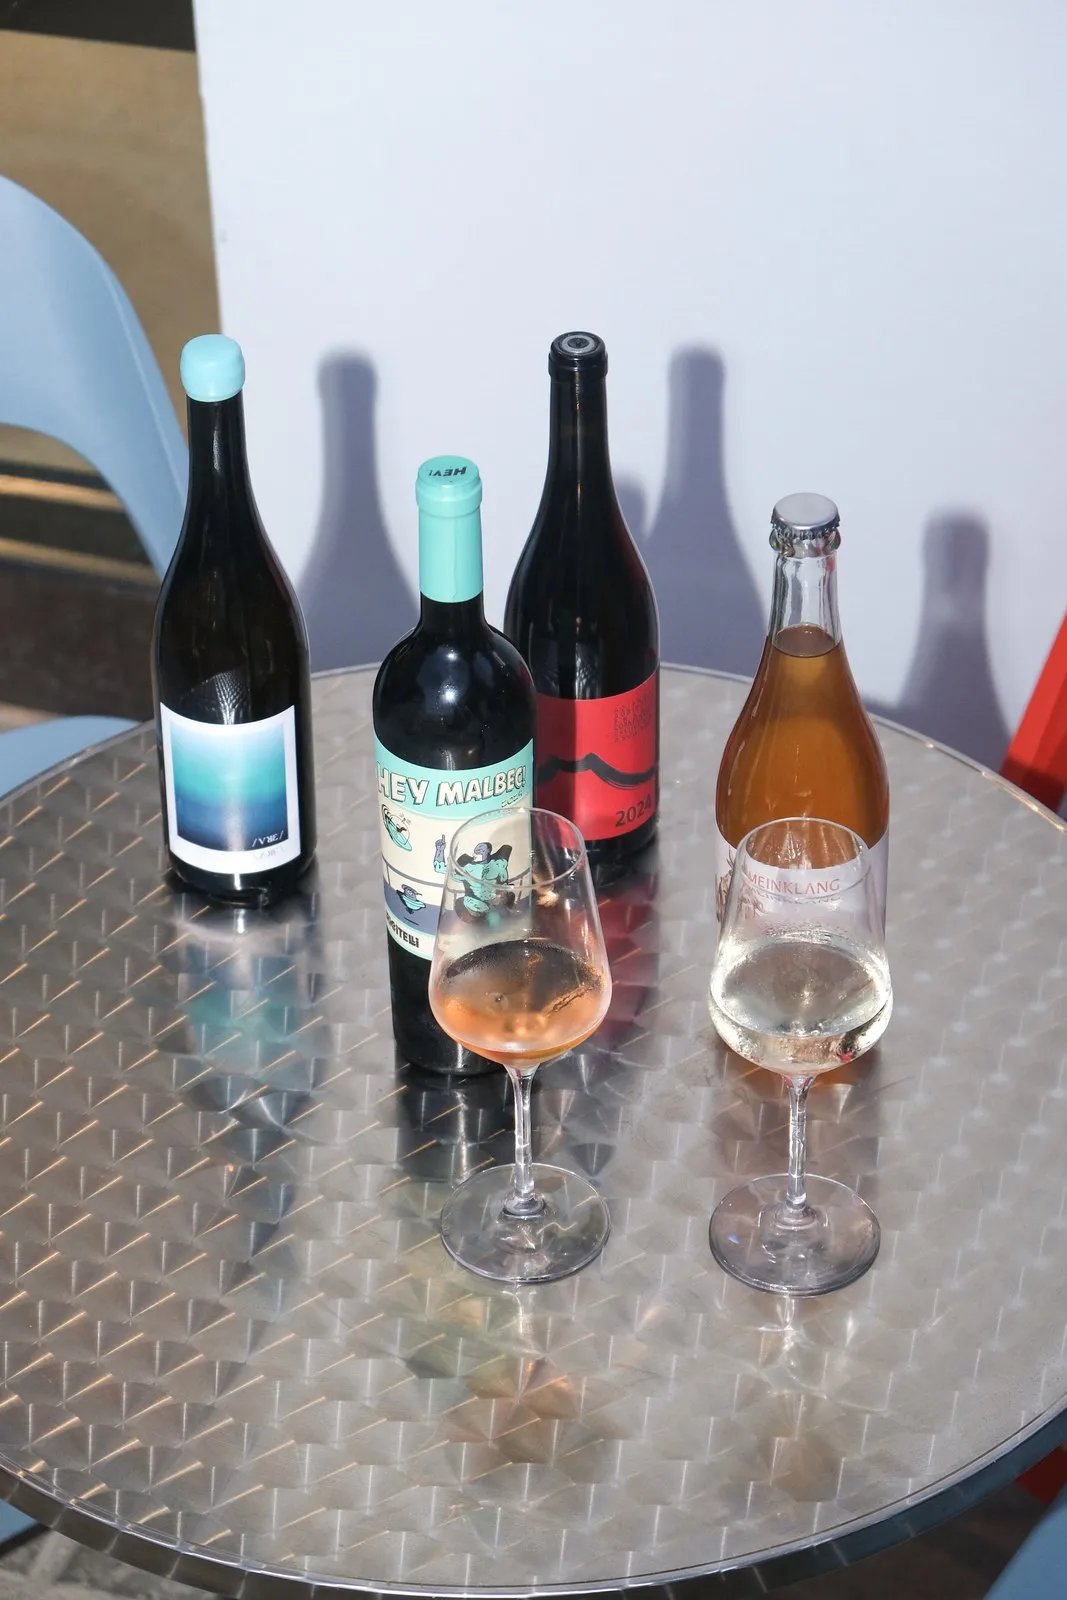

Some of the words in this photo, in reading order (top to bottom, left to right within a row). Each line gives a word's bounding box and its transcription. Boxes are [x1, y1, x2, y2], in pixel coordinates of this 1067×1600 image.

[376, 761, 430, 805] HEY
[436, 766, 526, 807] MALBEC!
[615, 795, 652, 827] 2024
[749, 874, 840, 895] MEINKLANG
